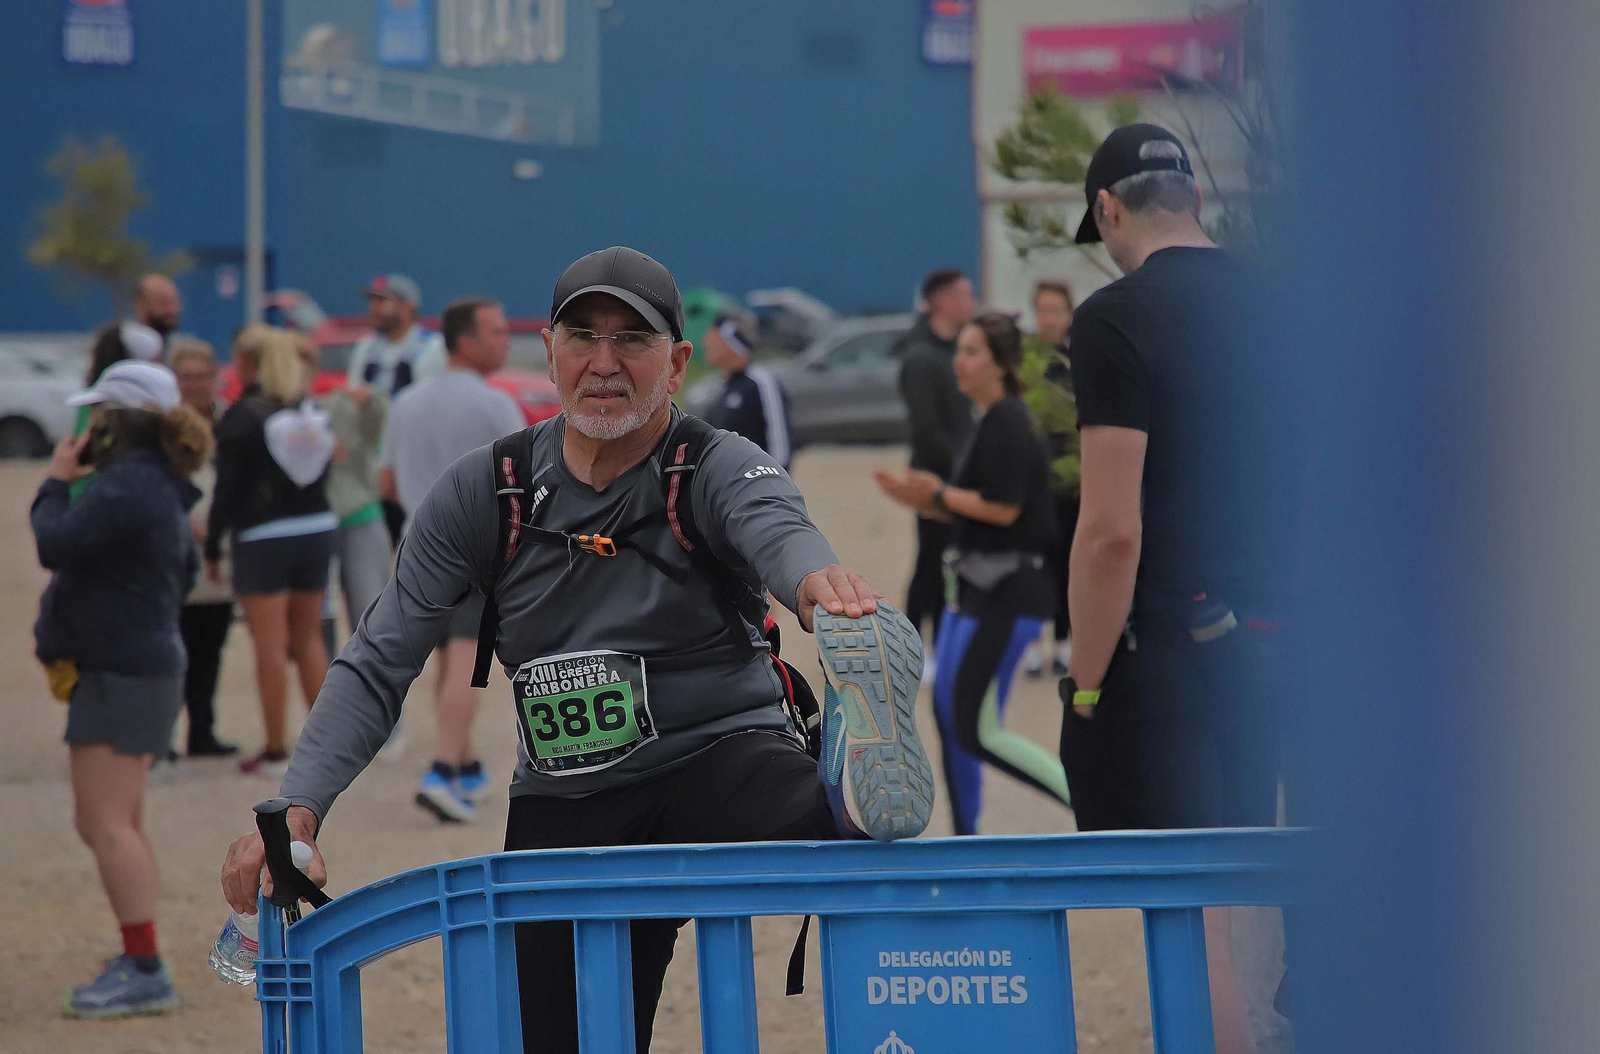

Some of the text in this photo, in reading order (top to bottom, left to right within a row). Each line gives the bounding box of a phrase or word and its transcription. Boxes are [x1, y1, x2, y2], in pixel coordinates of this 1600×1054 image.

[744, 465, 780, 479] Gill
[557, 656, 605, 671] EDICIÓN
[558, 663, 606, 680] CRESTA
[525, 669, 621, 697] CARBONERA
[530, 690, 627, 742] 386
[582, 738, 613, 750] FRANCISCO
[879, 947, 1012, 968] DELEGACIÓN DE
[867, 975, 1028, 1005] DEPORTES
